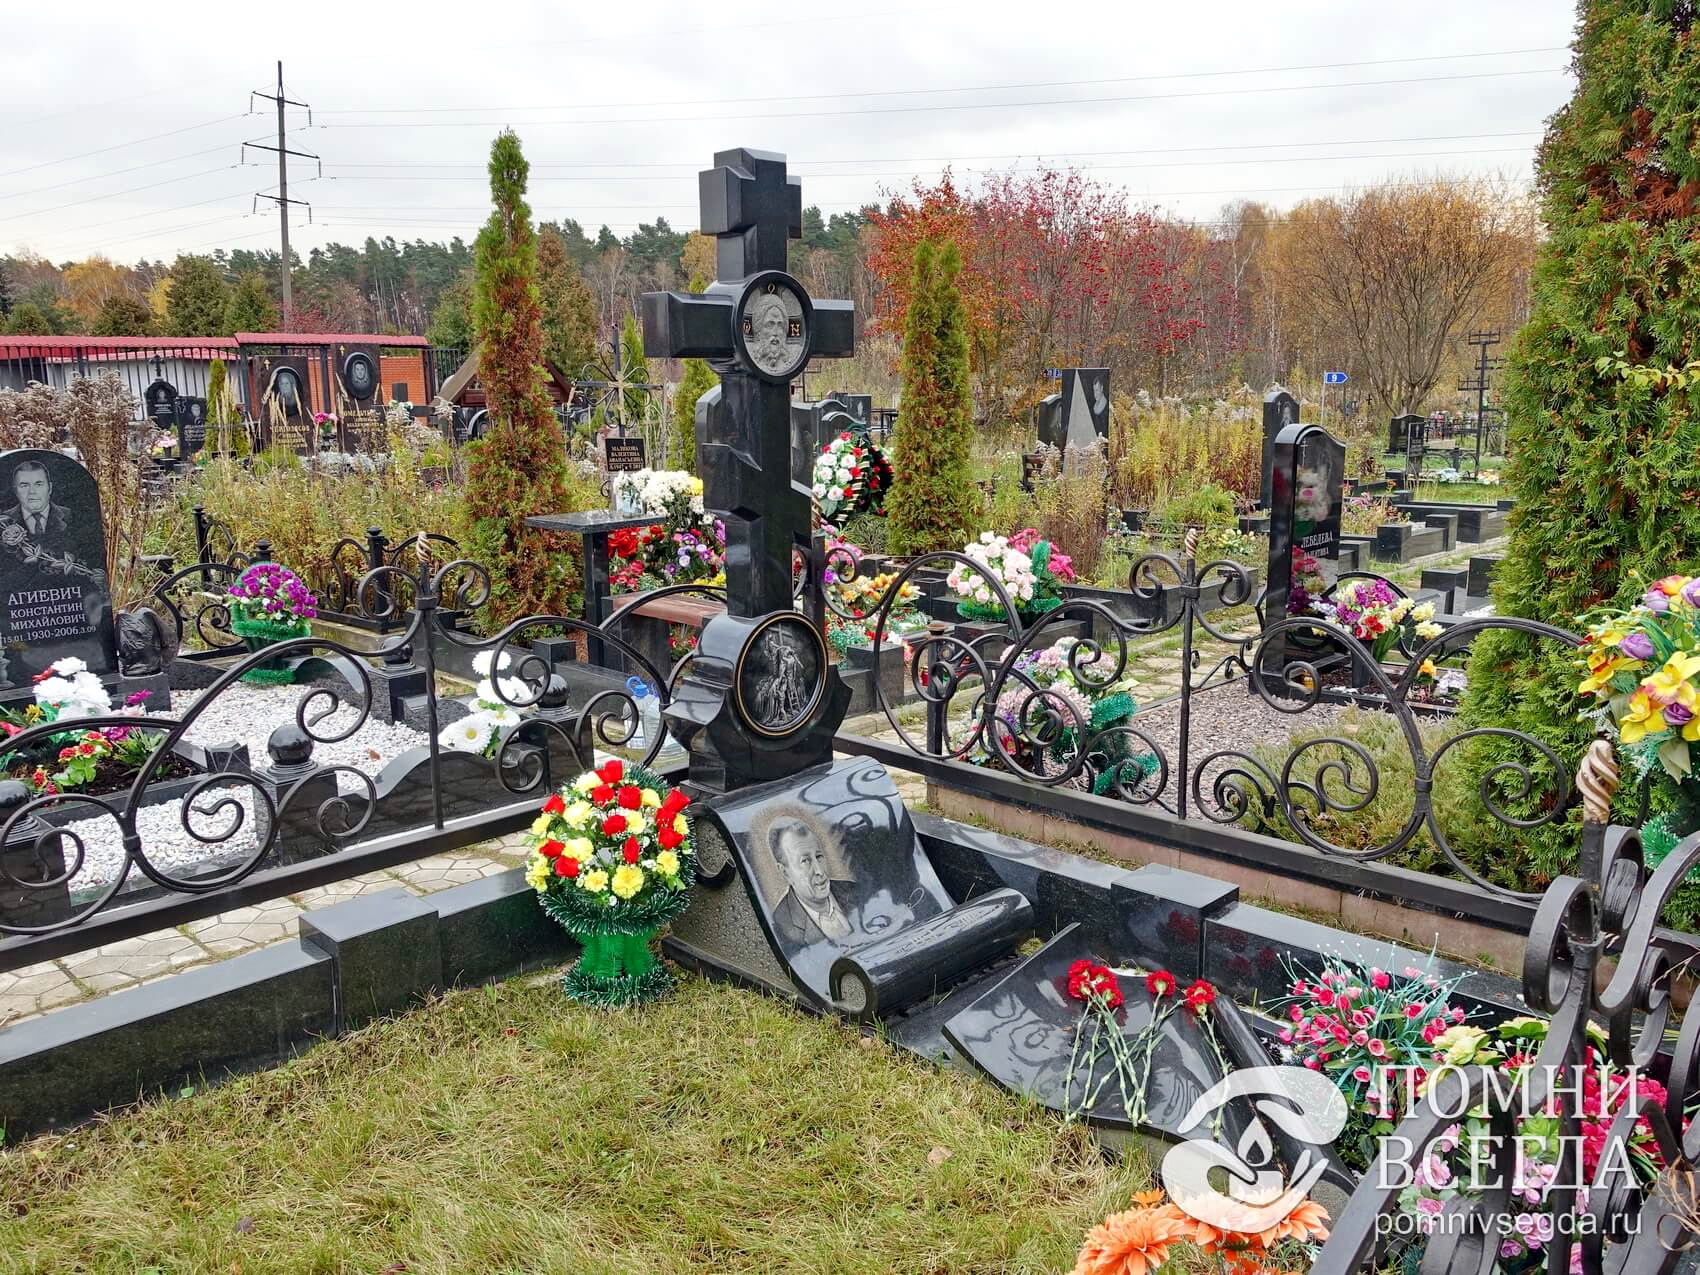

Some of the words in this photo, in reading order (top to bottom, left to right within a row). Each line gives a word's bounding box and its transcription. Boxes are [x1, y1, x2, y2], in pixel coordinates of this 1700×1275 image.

[1331, 374, 1337, 382] 9
[1301, 531, 1333, 548] ЛЕБЕДЕВА
[8, 586, 82, 606] АГИЕВИЧ
[10, 602, 83, 619] КОНСТАНТИН
[10, 613, 87, 631] МИХАЙЛОВИЧ
